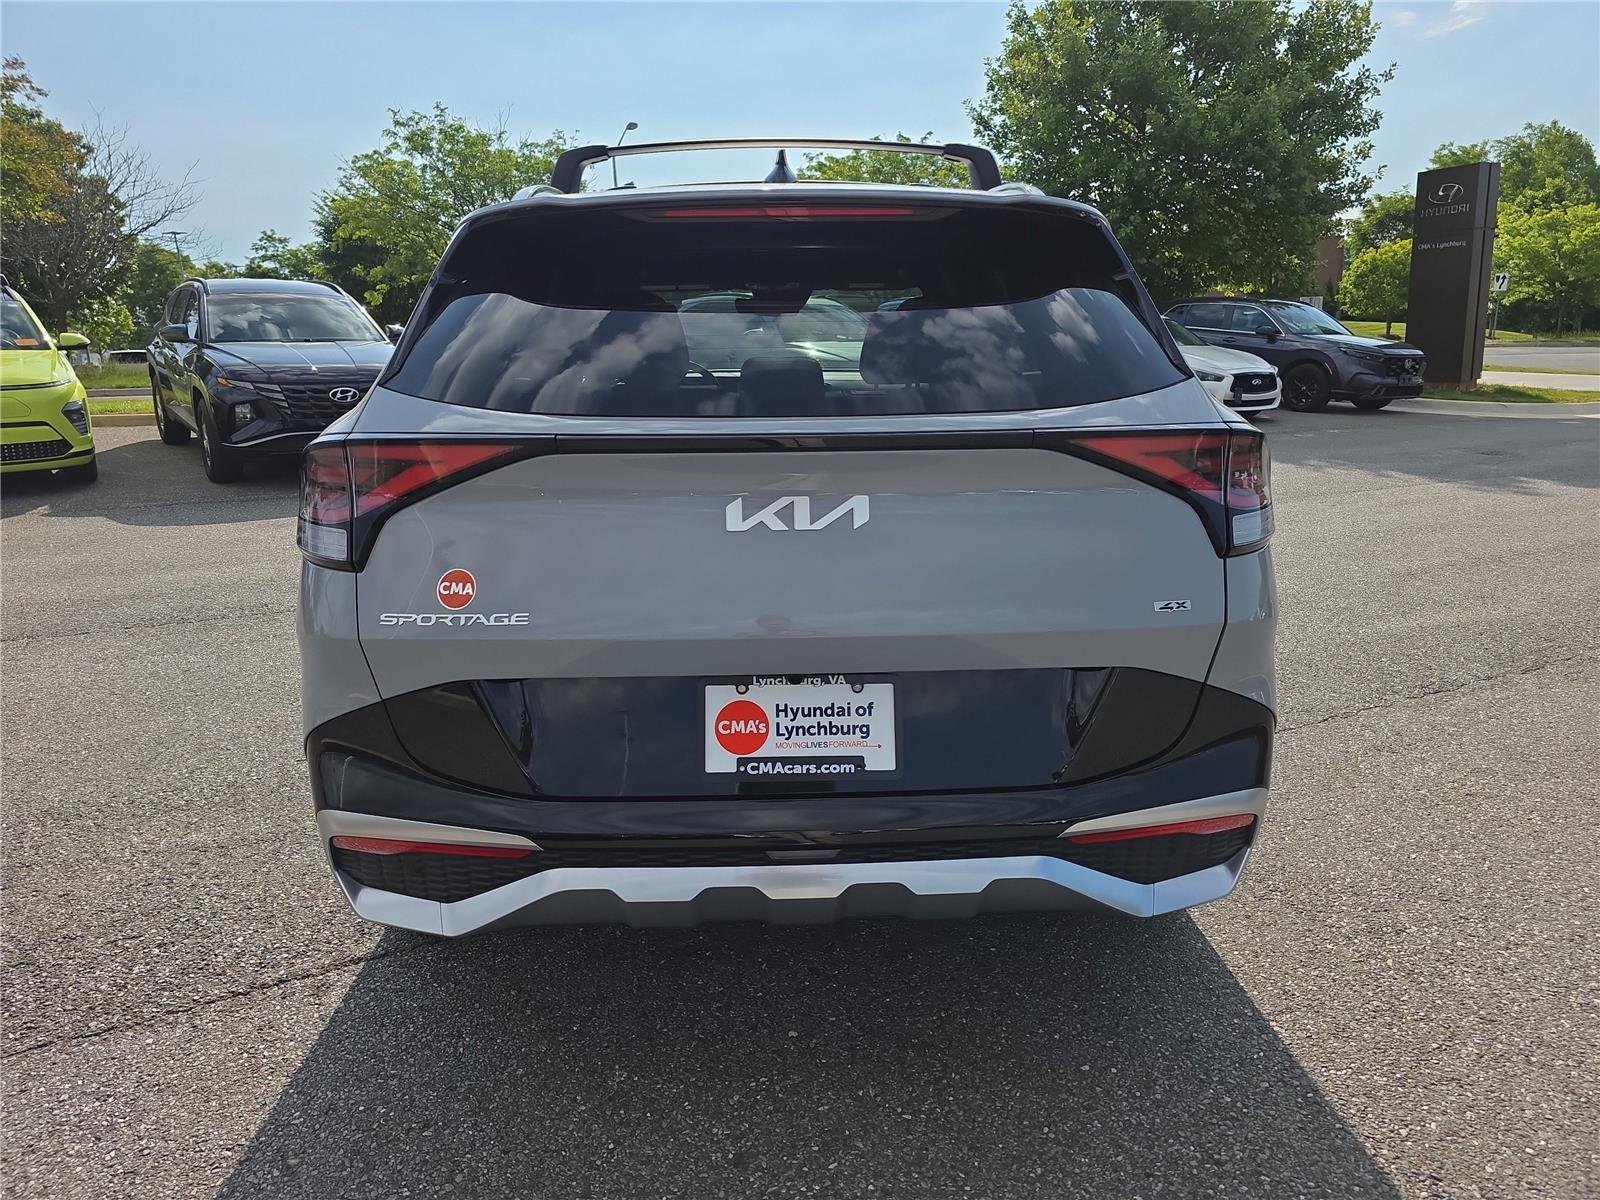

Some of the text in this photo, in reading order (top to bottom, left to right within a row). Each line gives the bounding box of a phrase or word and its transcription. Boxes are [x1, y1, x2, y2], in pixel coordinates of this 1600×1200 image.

[1420, 203, 1470, 217] HYUNDAI
[725, 495, 870, 532] KIA
[439, 581, 473, 596] CMA
[379, 613, 530, 626] SPORTAGE
[752, 674, 846, 688] Lynchurg, VA
[775, 702, 874, 722] Hyundai of
[718, 719, 767, 735] CMA's
[775, 721, 871, 741] Lynchburg
[746, 762, 855, 775] CMAcars.com
